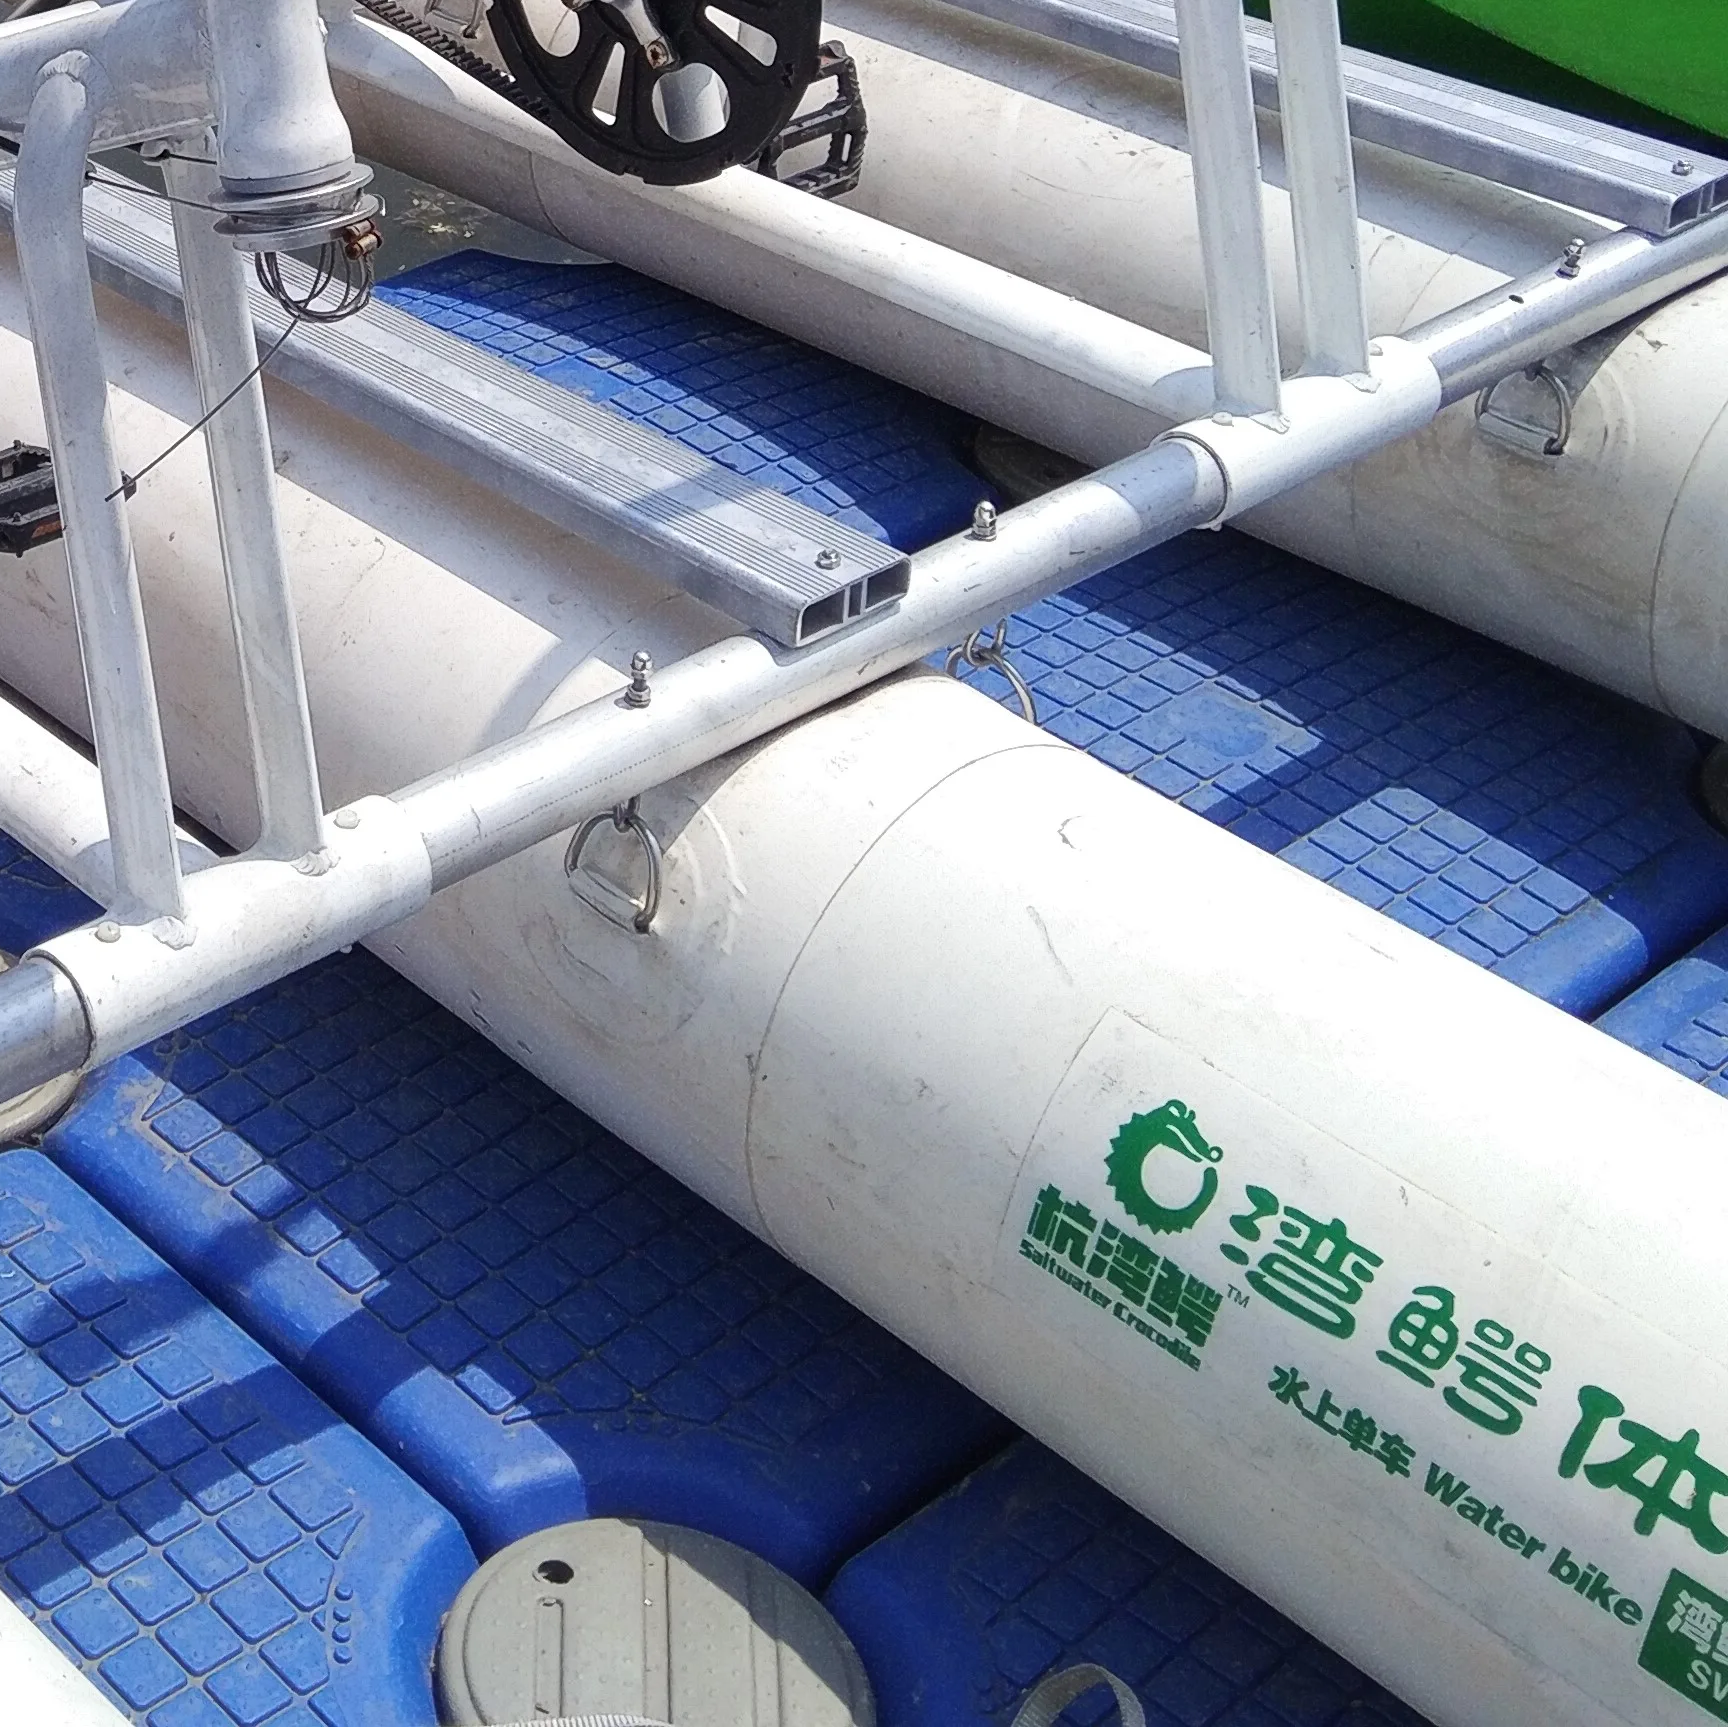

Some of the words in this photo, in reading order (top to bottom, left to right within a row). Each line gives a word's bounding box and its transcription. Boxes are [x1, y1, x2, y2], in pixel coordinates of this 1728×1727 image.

[1018, 1238, 1112, 1309] Saltwater
[1112, 1301, 1202, 1372] Crocodile
[1267, 1364, 1417, 1479] 水上单车
[1423, 1461, 1547, 1561] Water
[1547, 1547, 1645, 1628] bike
